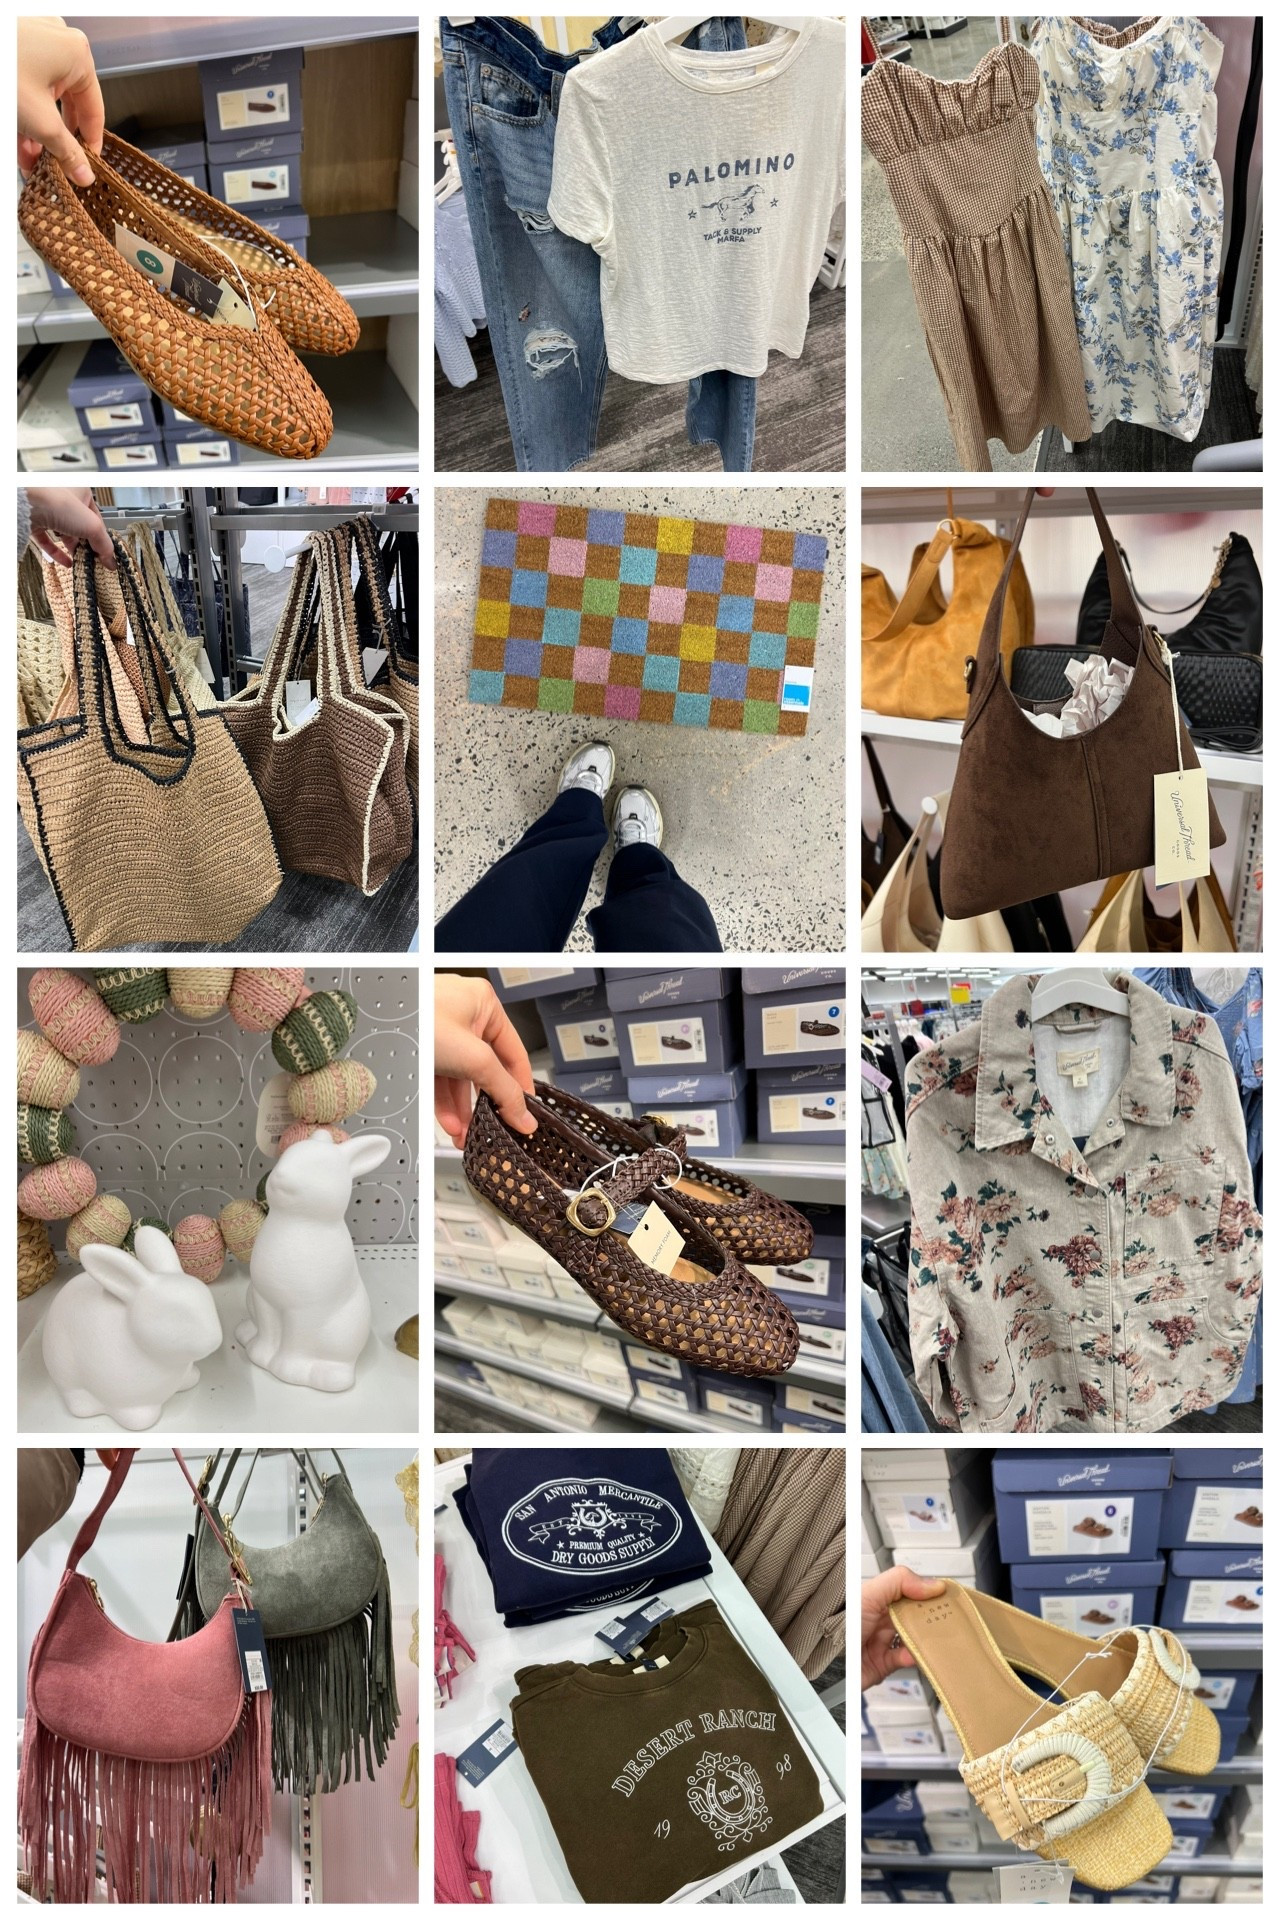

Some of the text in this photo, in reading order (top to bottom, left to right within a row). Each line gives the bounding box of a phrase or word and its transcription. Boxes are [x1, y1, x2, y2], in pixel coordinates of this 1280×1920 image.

[668, 152, 795, 189] PALOMINO
[703, 226, 762, 241] TACK & SUPPLY
[717, 235, 745, 244] MARFA
[1170, 790, 1196, 862] Universal Thread
[650, 1230, 672, 1265] MEMORY FOAM
[514, 1484, 664, 1521] SAN ANTONIO MERCANTILE
[551, 1536, 656, 1565] DRY GOODS SUPPLY
[569, 1533, 637, 1550] PREMIUM QUALITY
[611, 1708, 777, 1798] DESERT RANCH
[775, 1753, 792, 1781] 98
[718, 1784, 742, 1805] RC
[653, 1818, 671, 1840] 19
